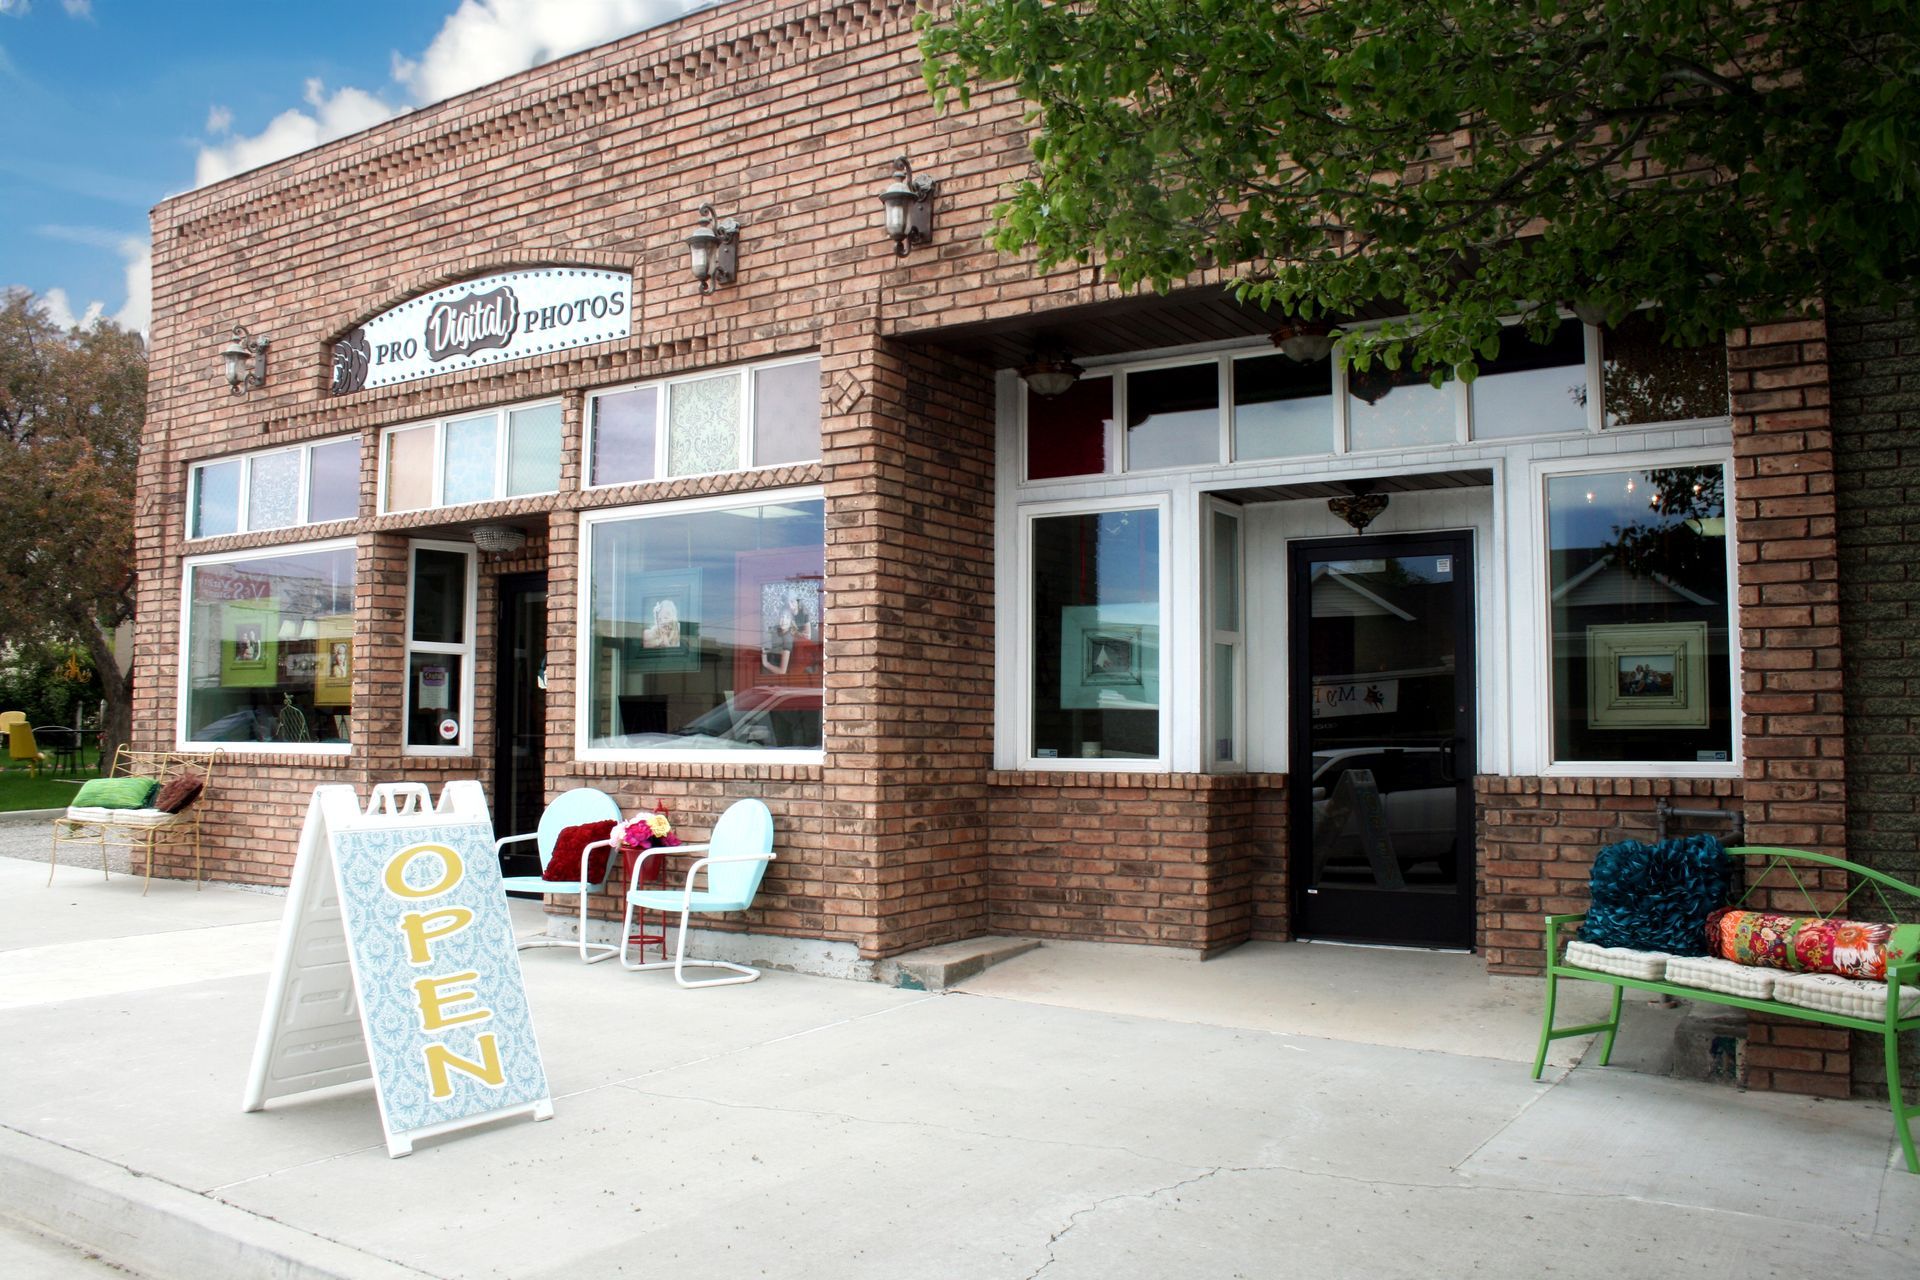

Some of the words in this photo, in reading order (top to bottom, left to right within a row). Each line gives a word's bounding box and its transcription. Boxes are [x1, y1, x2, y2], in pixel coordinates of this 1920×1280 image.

[376, 338, 417, 365] PRO
[429, 295, 508, 351] Digital
[523, 291, 625, 333] PHOTOS
[385, 845, 505, 1098] OPEN
